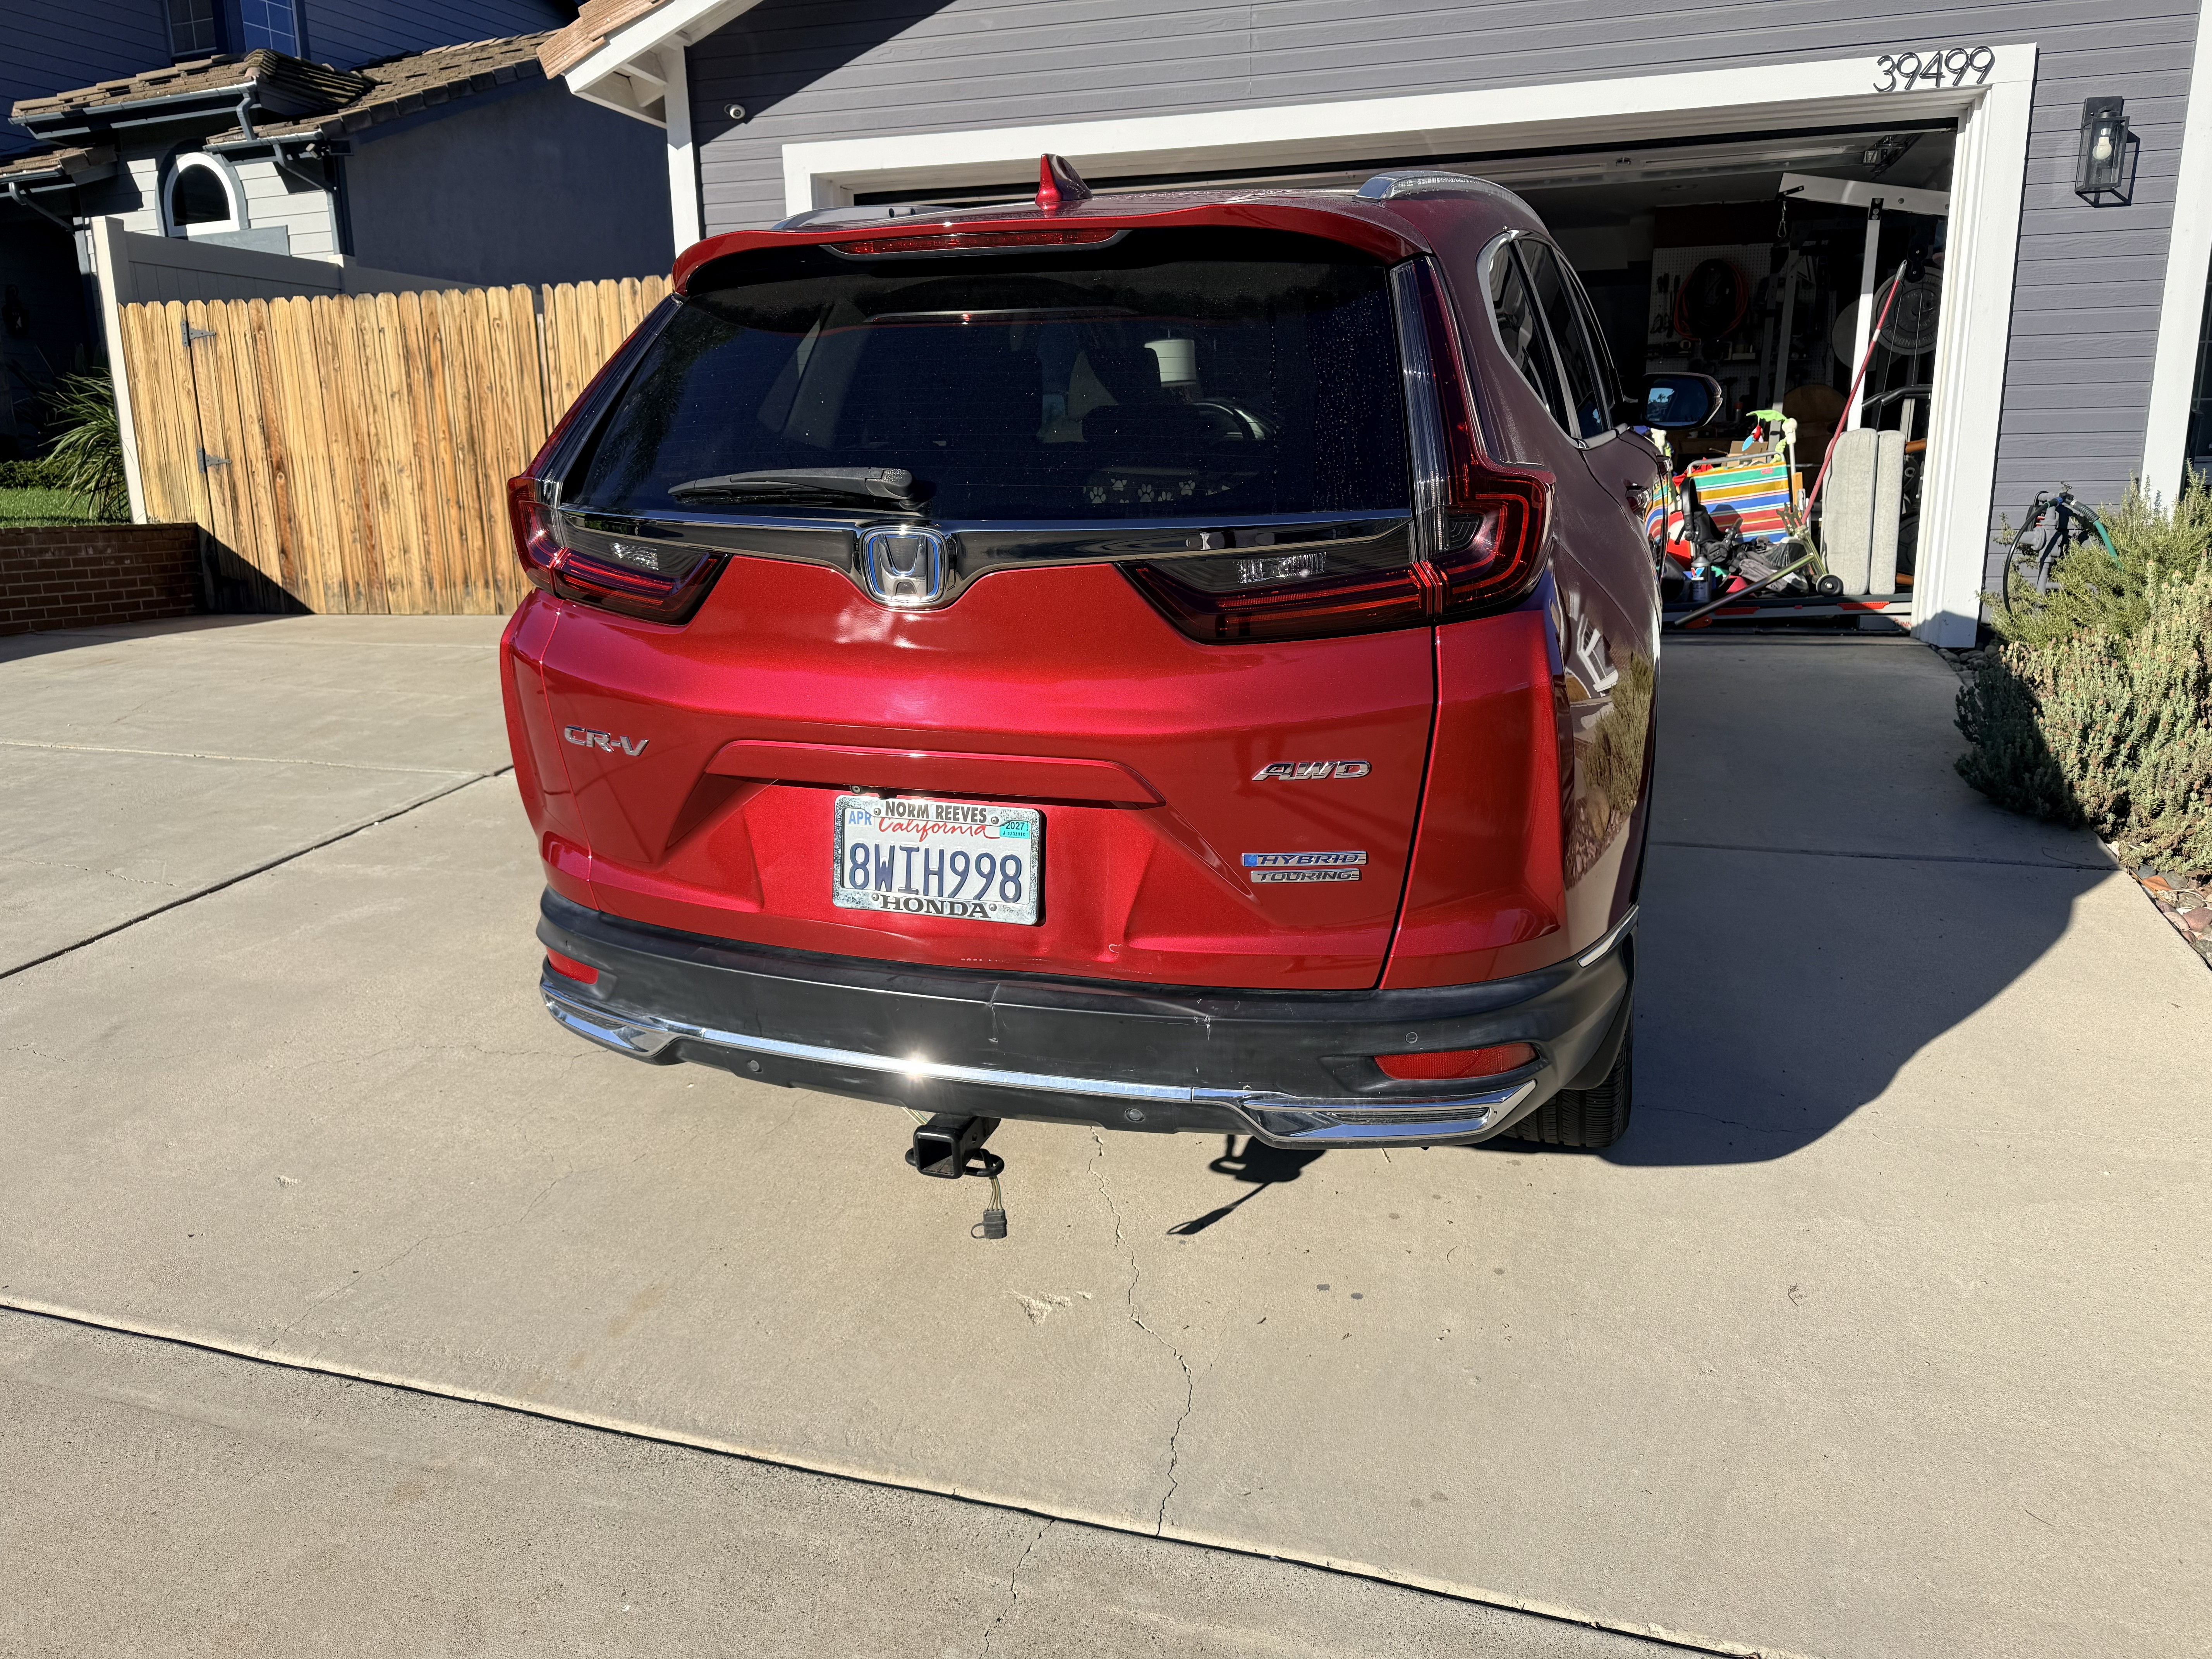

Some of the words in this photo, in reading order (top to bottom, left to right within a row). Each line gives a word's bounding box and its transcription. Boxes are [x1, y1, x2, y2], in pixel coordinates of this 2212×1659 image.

[1873, 46, 1995, 92] 39499
[564, 725, 649, 756] CR-V
[1252, 761, 1371, 781] AWD
[848, 811, 872, 825] APR
[885, 800, 929, 819] NORM
[936, 804, 987, 823] REEVES
[879, 817, 1000, 842] California
[1006, 822, 1025, 830] 2027
[1261, 854, 1359, 865] HYBRID
[849, 842, 1022, 903] 8WIH998
[1257, 871, 1352, 881] TOURING
[881, 894, 991, 919] HONDA
